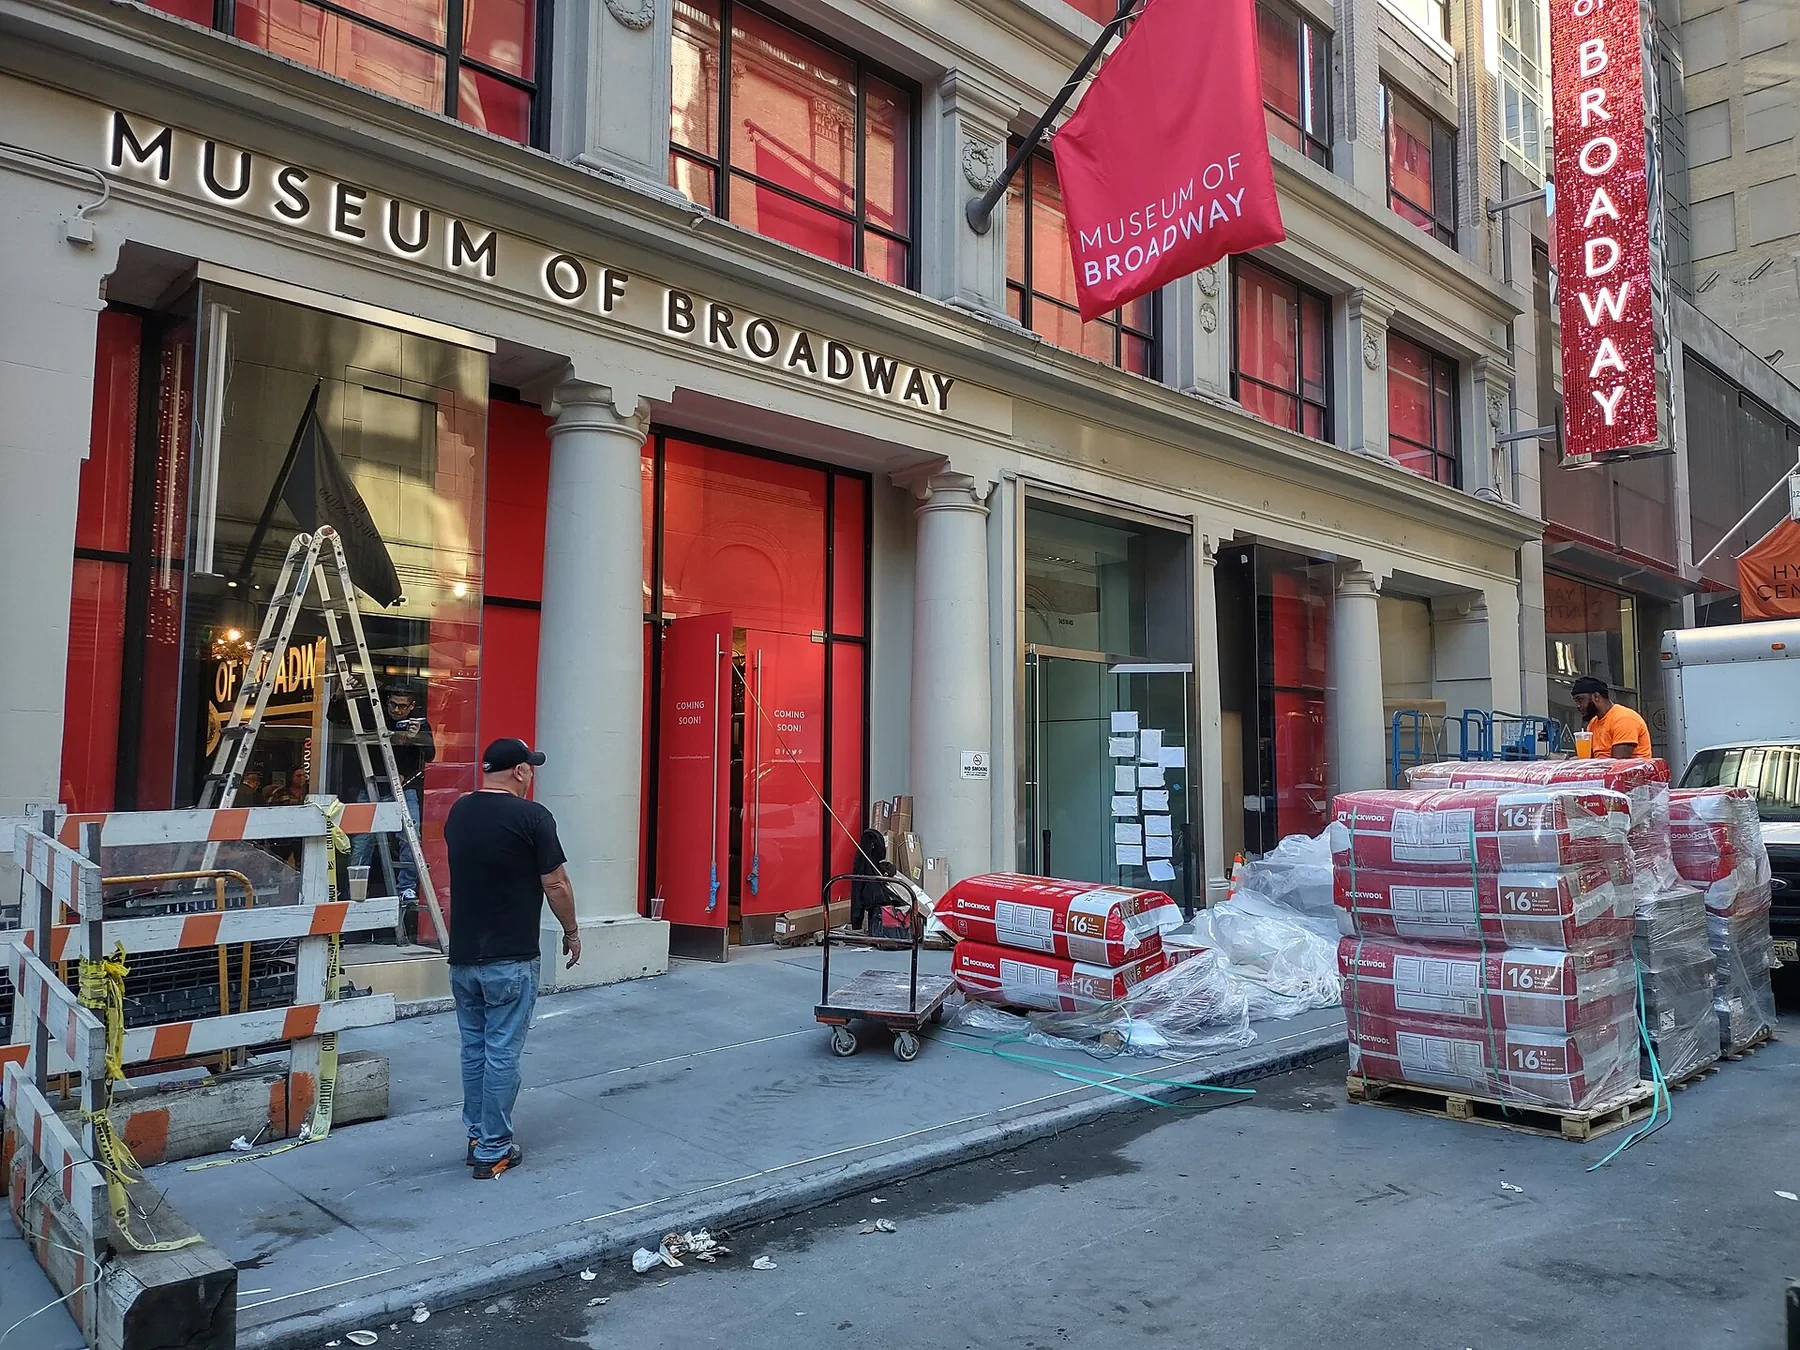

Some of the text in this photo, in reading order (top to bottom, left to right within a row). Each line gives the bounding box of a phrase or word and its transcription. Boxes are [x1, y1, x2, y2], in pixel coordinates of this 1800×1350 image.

[1573, 0, 1603, 17] O
[1079, 152, 1242, 253] MUSEUM OF
[1083, 187, 1246, 287] BROADWAY
[1578, 38, 1629, 427] BROADWAY
[111, 111, 954, 411] MUSEUM OF BROADWAY
[215, 660, 238, 703] OF
[675, 700, 705, 711] COMING
[773, 709, 805, 719] COMING
[678, 715, 702, 725] SOON!
[776, 723, 802, 732] SOON!
[1347, 813, 1386, 822] RCKWOOL
[964, 901, 991, 911] ROCKWOOL
[969, 959, 995, 970] ROCKWOOL
[1358, 1033, 1391, 1044] OCKWOOL
